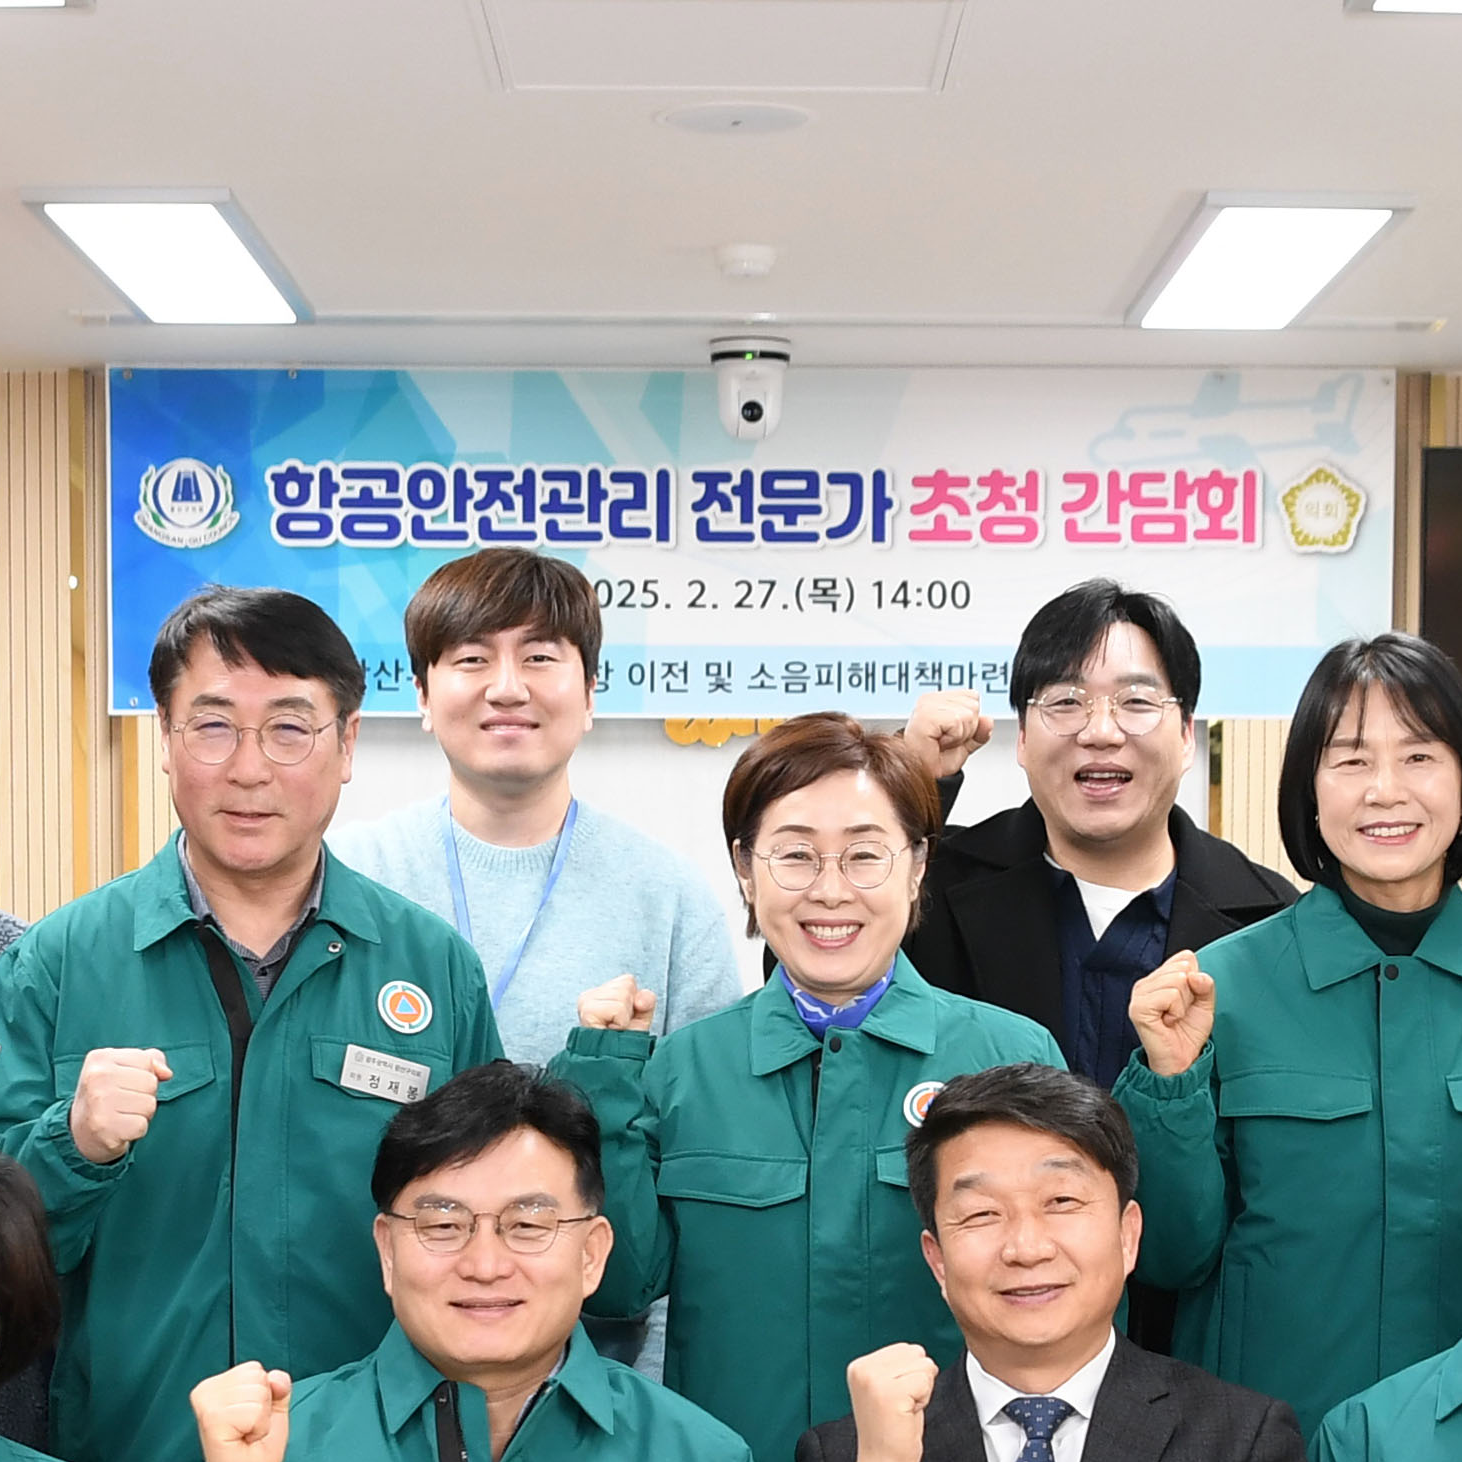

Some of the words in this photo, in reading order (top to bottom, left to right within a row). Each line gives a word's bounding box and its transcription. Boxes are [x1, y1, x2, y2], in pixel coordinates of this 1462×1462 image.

[269, 466, 672, 543] 항공안전관리
[691, 468, 894, 544] 전문가
[907, 468, 1040, 544] 초청
[1060, 468, 1257, 544] 간담회
[594, 578, 672, 609] 025.
[687, 579, 719, 609] 2.
[734, 577, 855, 612] 27.(목)
[871, 579, 971, 610] 14:00
[627, 659, 690, 694] 이전
[704, 660, 733, 694] 및
[746, 659, 1009, 694] 소음피해대책마련
